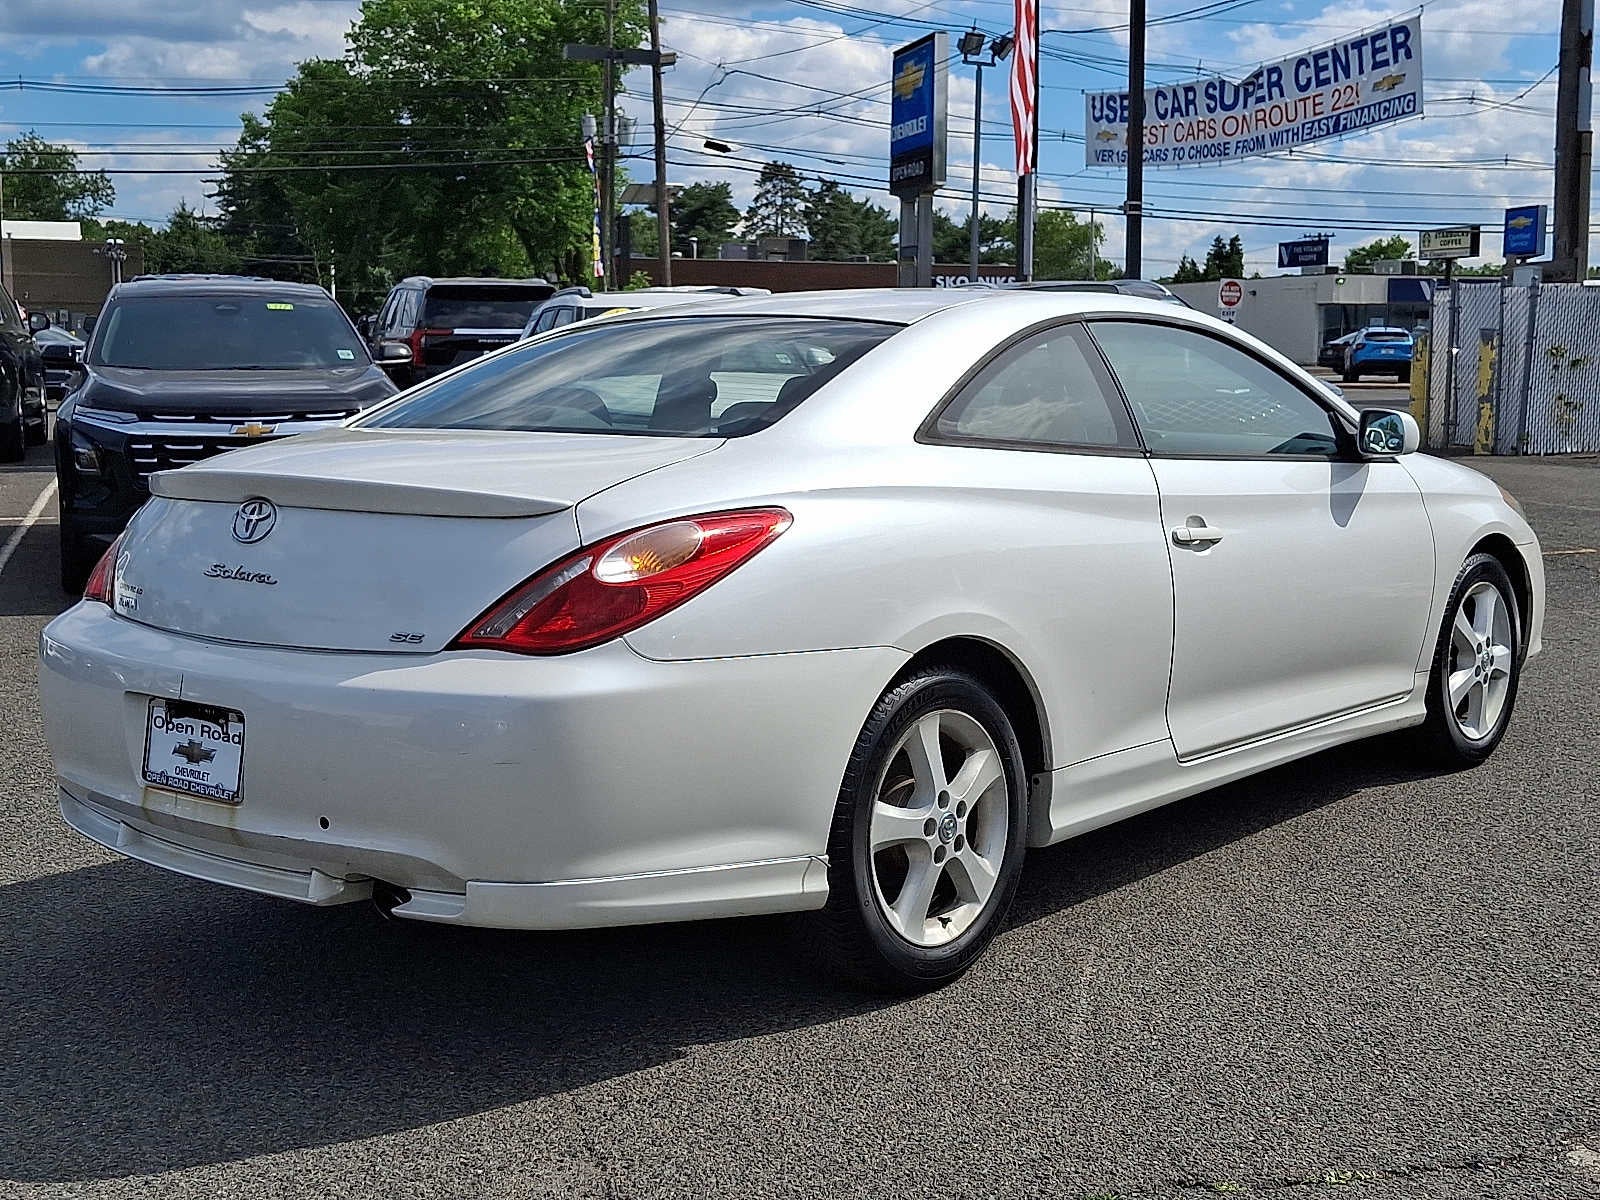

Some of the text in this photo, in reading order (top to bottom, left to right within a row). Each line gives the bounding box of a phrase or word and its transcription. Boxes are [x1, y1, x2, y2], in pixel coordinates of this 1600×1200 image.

[1091, 25, 1413, 123] USE CAR SUPER CENTER
[891, 115, 928, 142] CHEVROLET
[1142, 149, 1169, 163] CARS
[1172, 147, 1186, 161] TO
[1188, 141, 1231, 159] CHOOSE
[1234, 135, 1266, 155] FROM
[1269, 126, 1300, 148] WITH
[1302, 117, 1337, 140] EASY
[1339, 94, 1416, 131] FINANCING
[1174, 118, 1217, 143] CARS
[1222, 113, 1252, 137] ON
[1255, 92, 1324, 131] ROUTE
[1439, 238, 1462, 247] COFFEE
[203, 563, 279, 585] Solara
[388, 632, 426, 644] SE
[153, 715, 242, 746] Open Road
[146, 771, 234, 800] OPEN ROAD CHEVROLET
[174, 765, 211, 782] CHEVROLET
